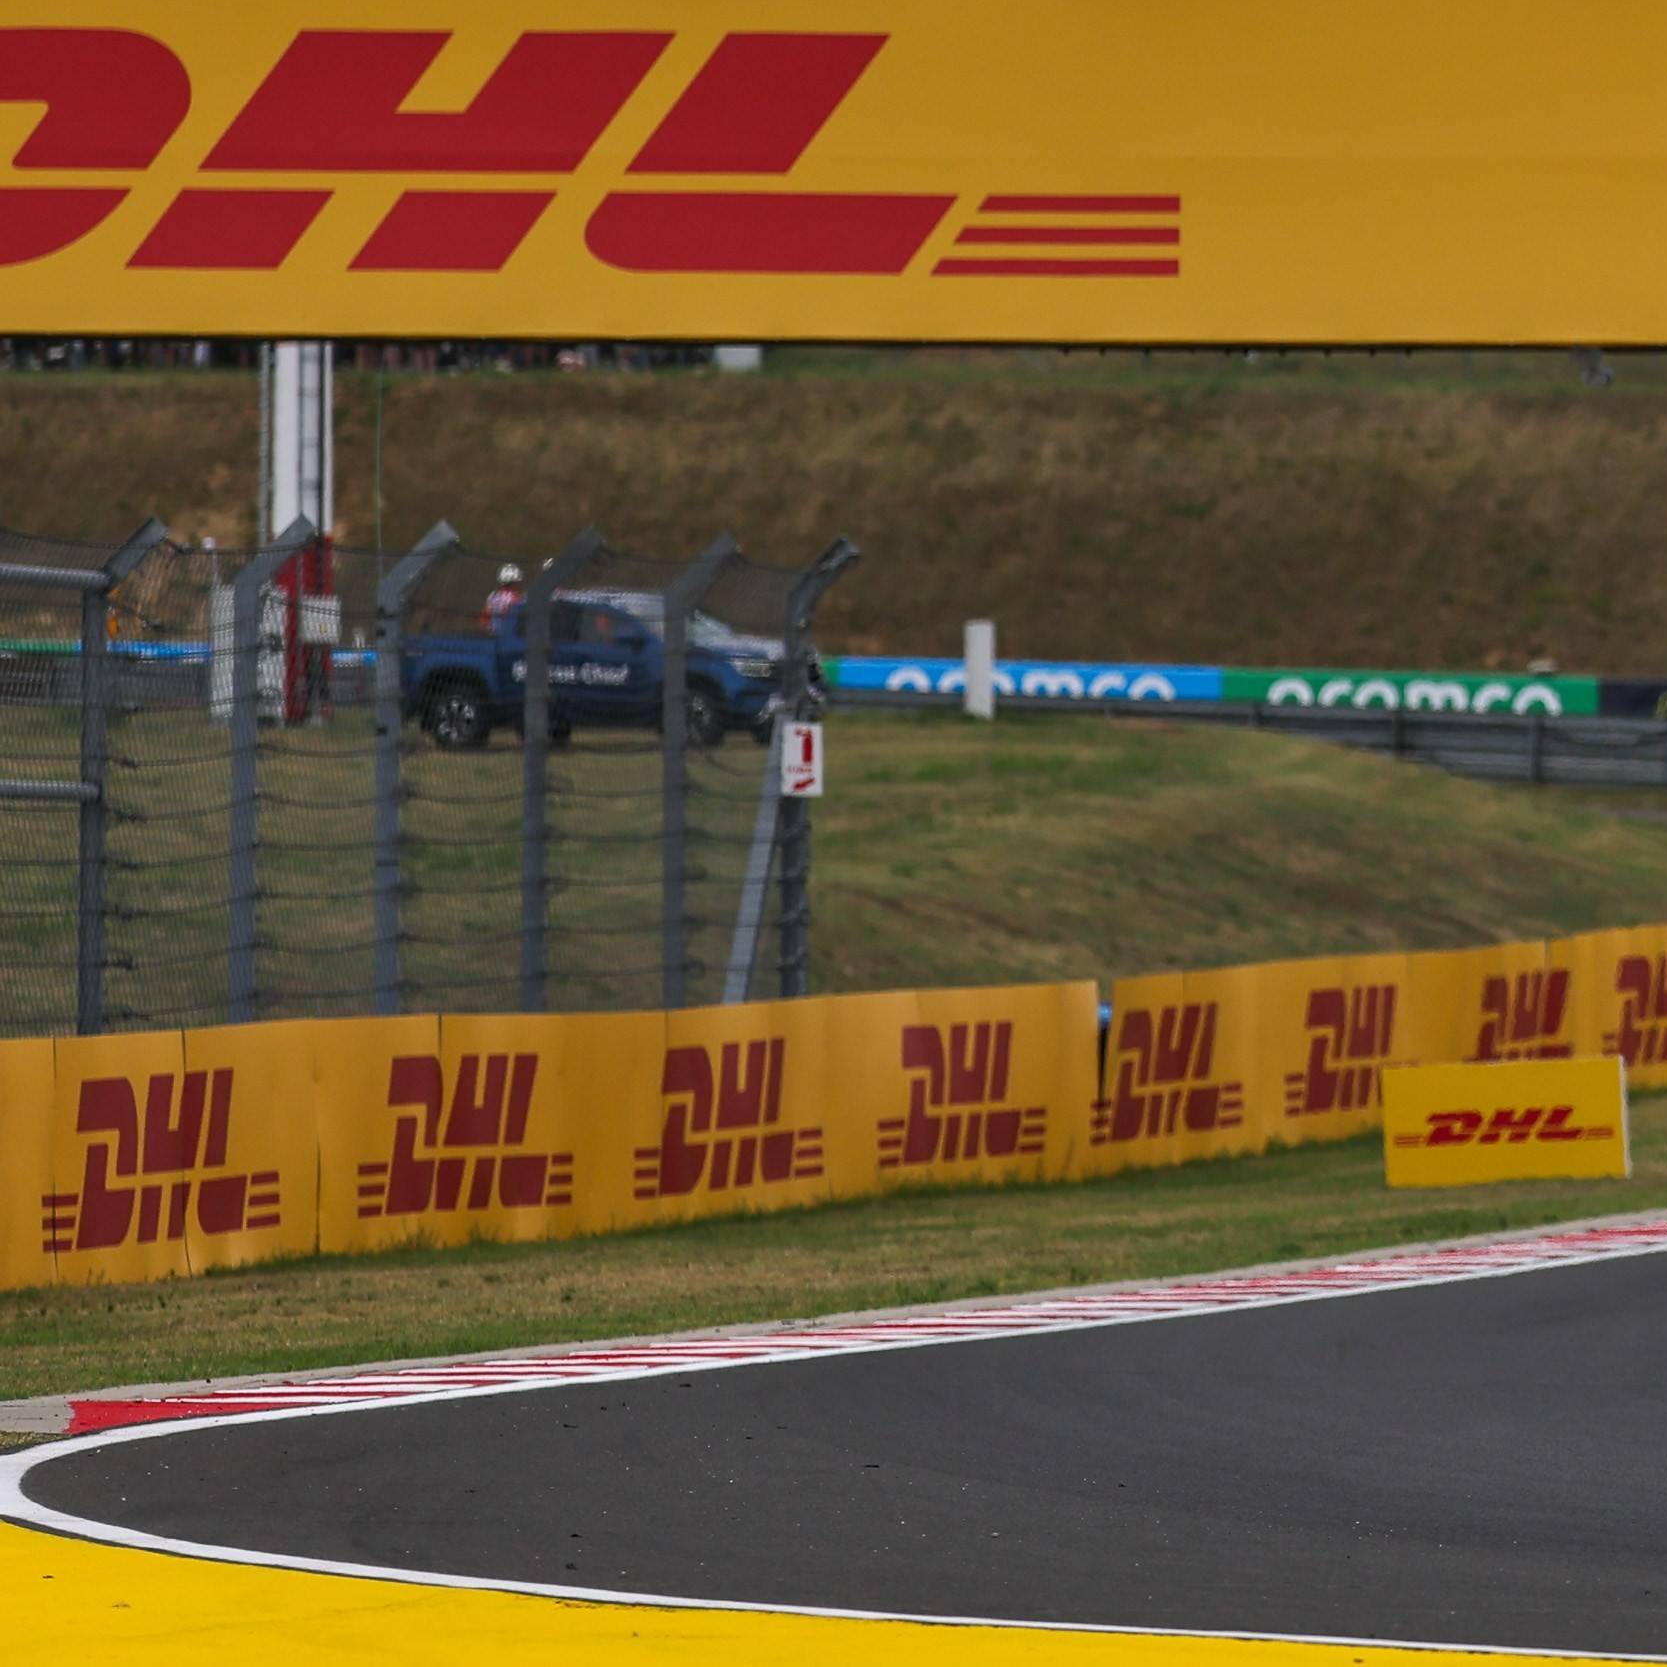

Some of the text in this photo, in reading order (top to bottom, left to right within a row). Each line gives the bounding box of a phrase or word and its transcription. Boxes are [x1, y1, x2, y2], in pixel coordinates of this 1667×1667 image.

[385, 1053, 548, 1215] DHL
[659, 1038, 795, 1197] DHL
[902, 1021, 1021, 1166] DHL
[1111, 1002, 1220, 1142] DHL
[1425, 1106, 1581, 1147] DHL
[75, 1067, 247, 1251] DHL
